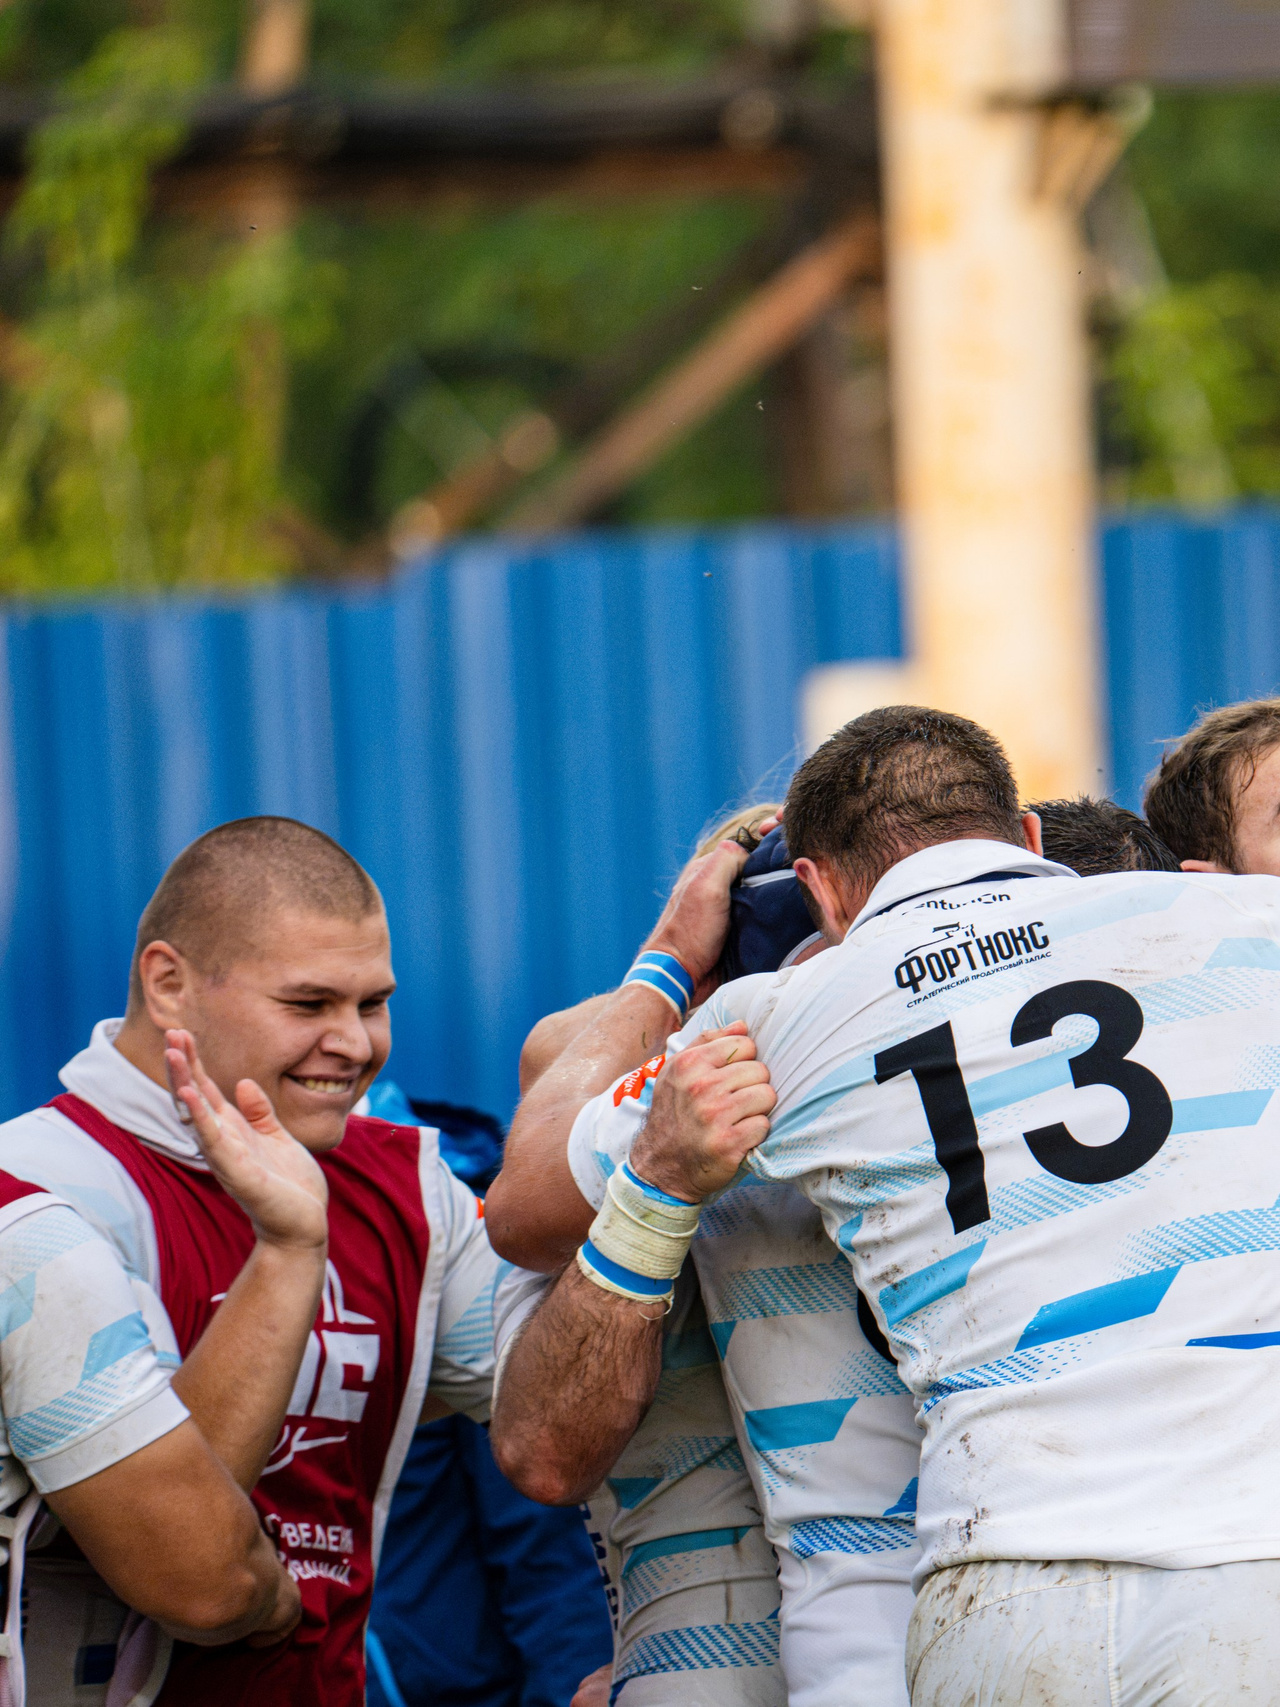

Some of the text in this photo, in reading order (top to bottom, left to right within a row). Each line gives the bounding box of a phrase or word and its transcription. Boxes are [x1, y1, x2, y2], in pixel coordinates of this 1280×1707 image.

[895, 921, 1050, 994] ФОРТНОКС
[907, 951, 1052, 1008] СТРАТЕГИЧЕСКИЙ ПРОДУКТОВЫЙ ЗАПАС
[873, 980, 1173, 1235] 13
